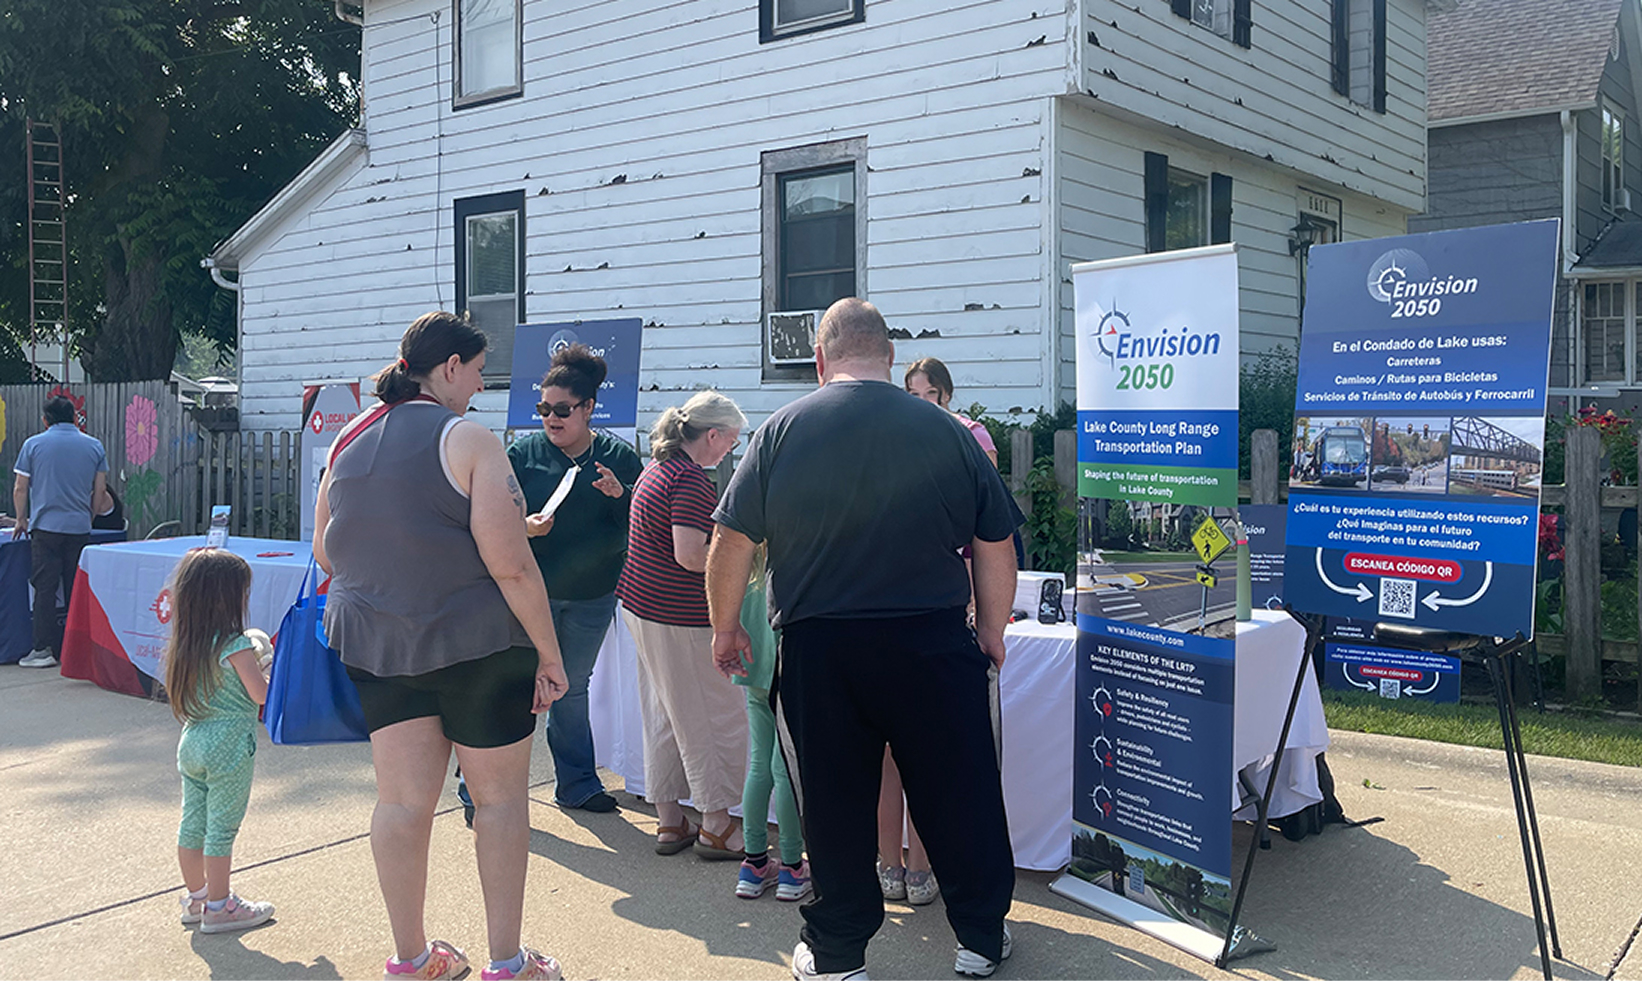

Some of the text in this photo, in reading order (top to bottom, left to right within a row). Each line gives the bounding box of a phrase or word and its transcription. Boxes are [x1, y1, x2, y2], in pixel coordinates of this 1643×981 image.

[1393, 275, 1478, 298] Envision
[1391, 298, 1441, 318] 2050
[1116, 326, 1220, 359] Envision
[1333, 336, 1507, 352] En el Condado de Lake usas:
[1386, 356, 1441, 367] Carreteras
[1116, 363, 1174, 390] 2050
[1335, 375, 1376, 385] Caminos
[1387, 374, 1416, 383] Rutas
[1418, 375, 1441, 385] para
[1444, 372, 1498, 382] Bicicletas
[1304, 389, 1535, 402] Servicios de Tránsito de Autobús y Ferrocarril
[1084, 421, 1219, 438] Lake County Long Range
[1095, 440, 1201, 455] Transportation Plan
[1084, 469, 1218, 485] Shaping the future of transportation
[1119, 485, 1174, 498] in Lake County
[1294, 502, 1528, 525] ¿Cuál es tu experiencia utilizando estos recursos?
[1336, 518, 1472, 536] ¿Qué Imaginas para el futuro
[1328, 530, 1480, 551] del transporte en tu comunidad?
[1351, 558, 1453, 577] ESCANEA CÓDIGO QR
[1107, 625, 1184, 646] www.lakecounty.com
[1097, 645, 1195, 672] KEY ELEMENTS OF THE LRTP
